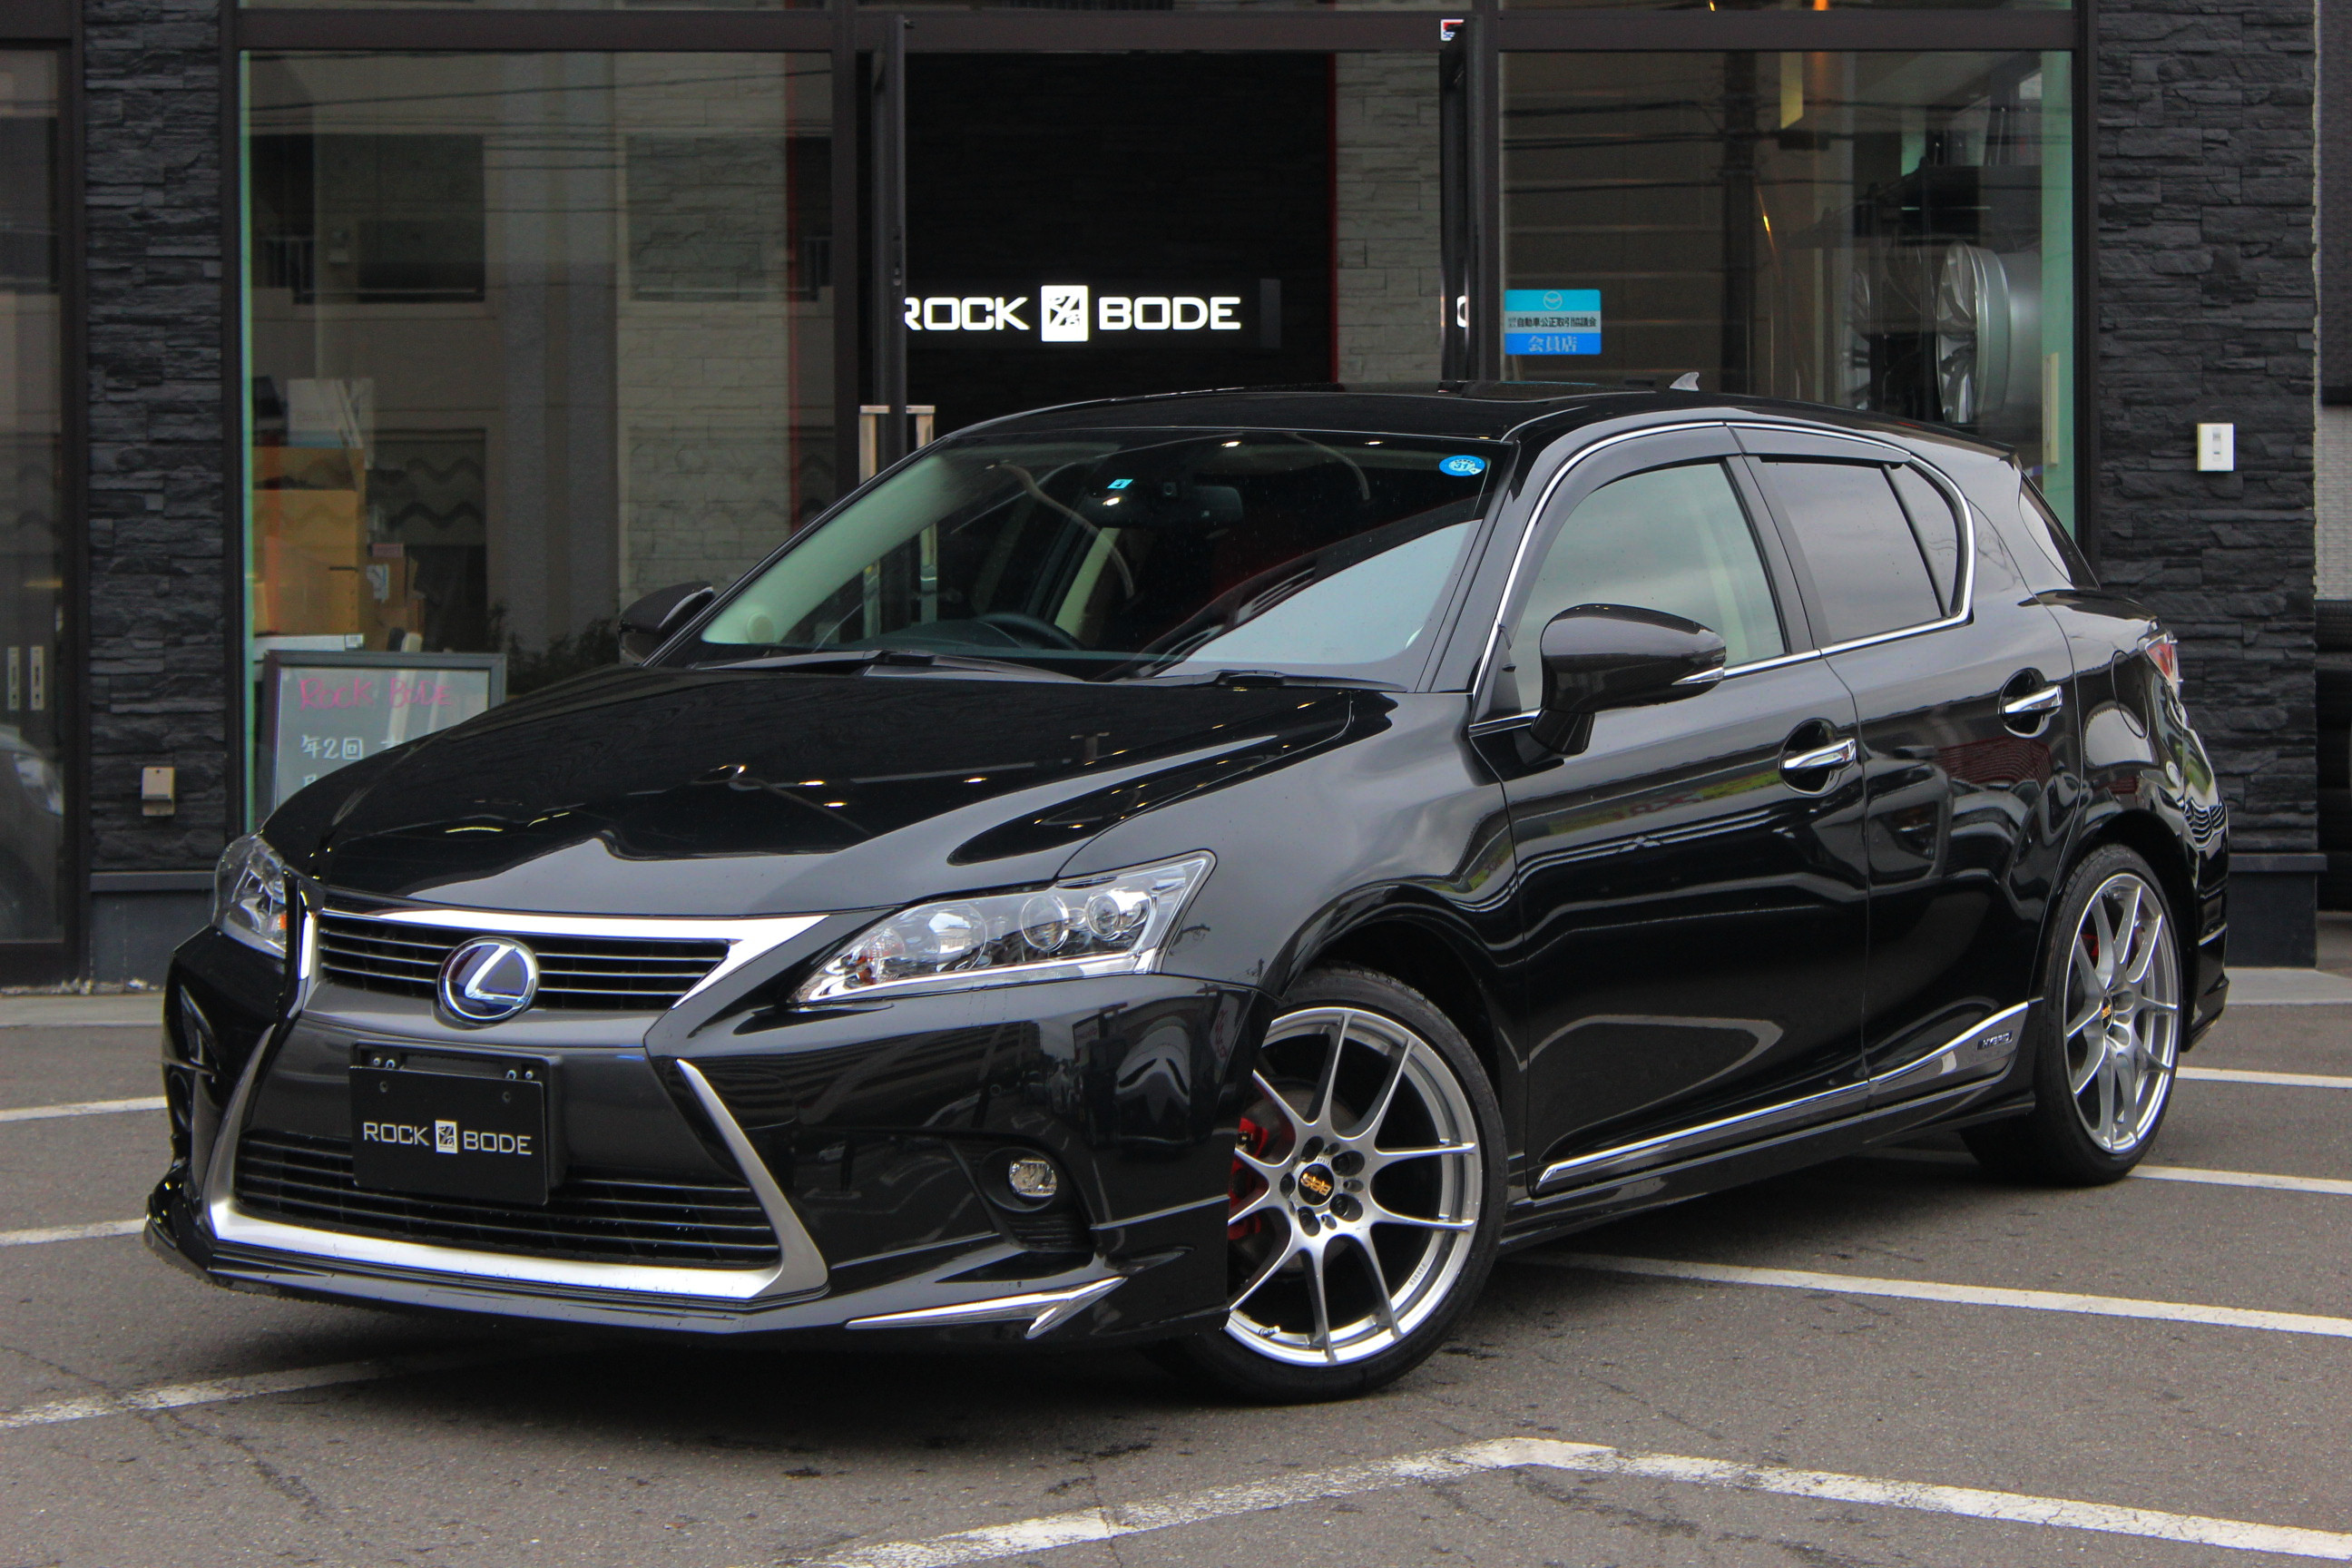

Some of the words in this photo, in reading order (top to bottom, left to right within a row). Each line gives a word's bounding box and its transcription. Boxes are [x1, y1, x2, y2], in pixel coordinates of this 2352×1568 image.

[904, 297, 1030, 330] ROCK
[1098, 296, 1242, 330] BODE
[1528, 336, 1577, 352] 会員店
[363, 1122, 430, 1146] ROCK
[463, 1131, 533, 1155] BODE
